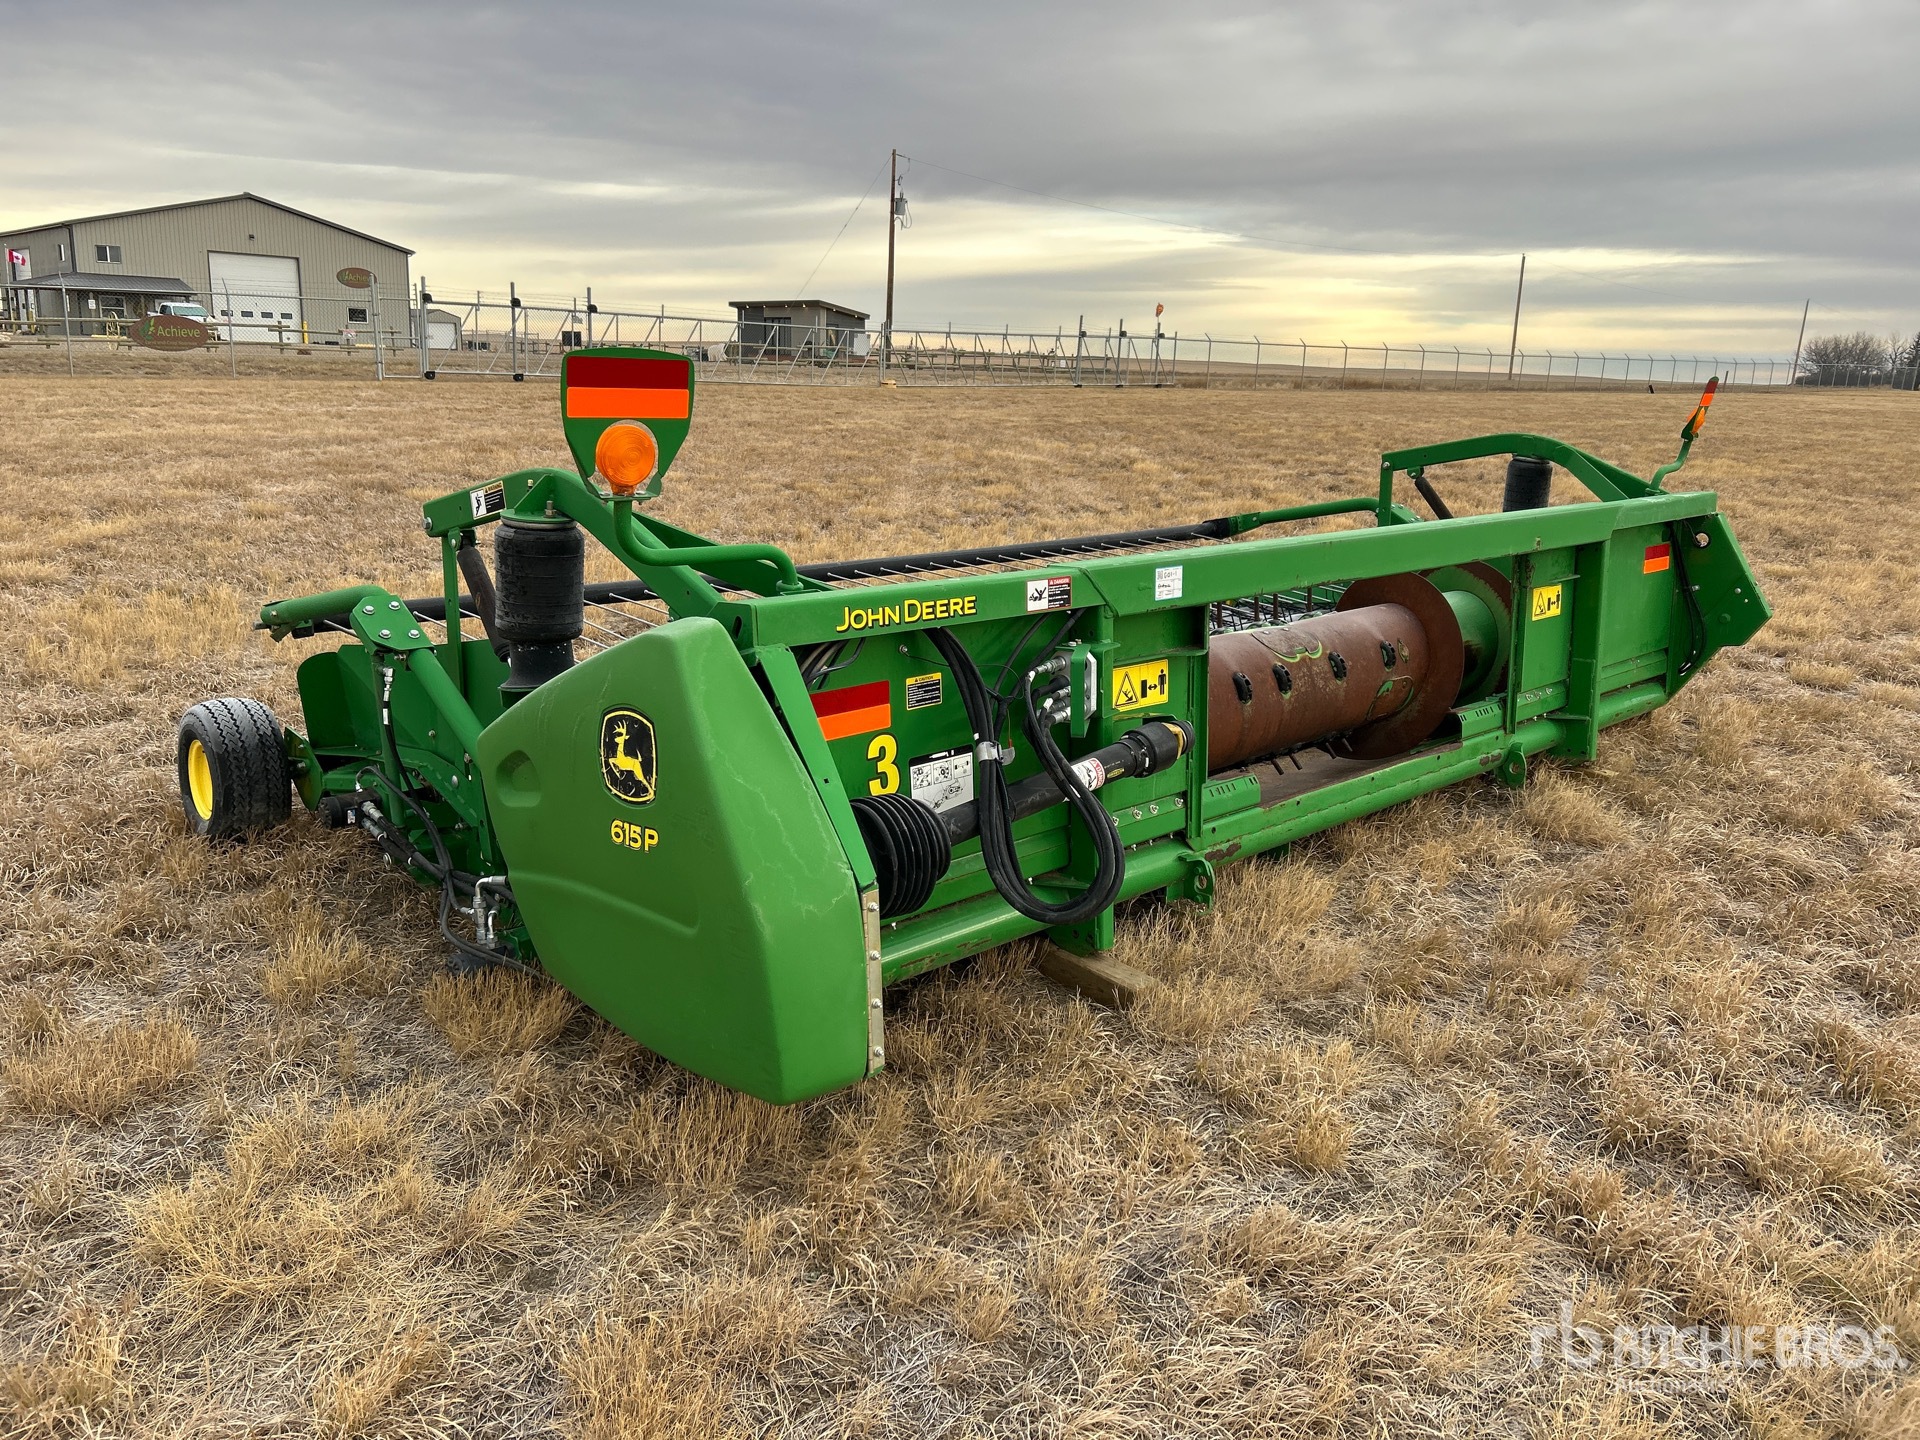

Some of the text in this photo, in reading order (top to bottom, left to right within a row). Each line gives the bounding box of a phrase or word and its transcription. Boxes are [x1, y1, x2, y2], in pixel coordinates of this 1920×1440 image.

[157, 325, 200, 338] Achieve
[836, 595, 977, 632] JOHN DEERE
[867, 733, 900, 797] 3
[610, 818, 659, 853] 615P
